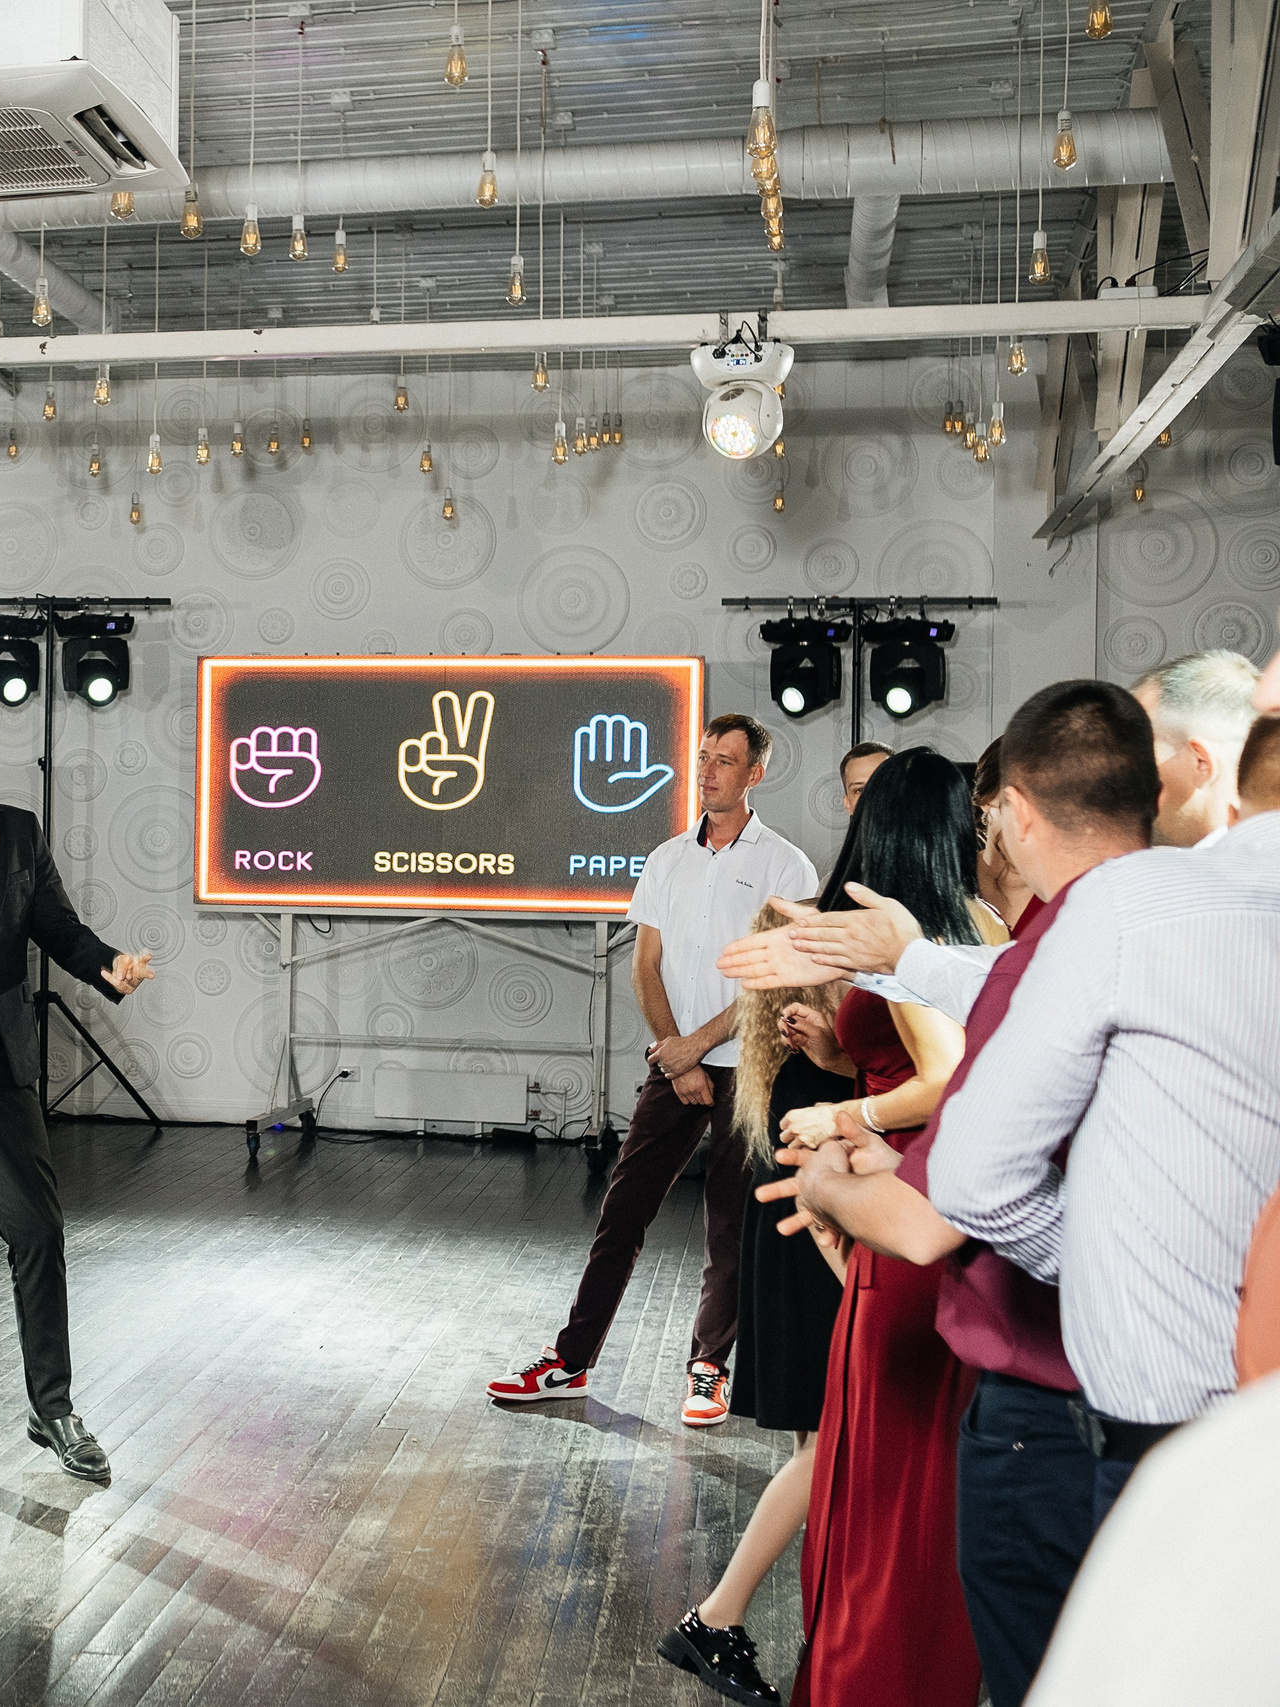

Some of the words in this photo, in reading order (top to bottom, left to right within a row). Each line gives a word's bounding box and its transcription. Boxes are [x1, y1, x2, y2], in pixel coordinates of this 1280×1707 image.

[234, 850, 314, 871] ROCK
[373, 851, 515, 875] SCISSORS
[569, 854, 647, 878] PAPE
